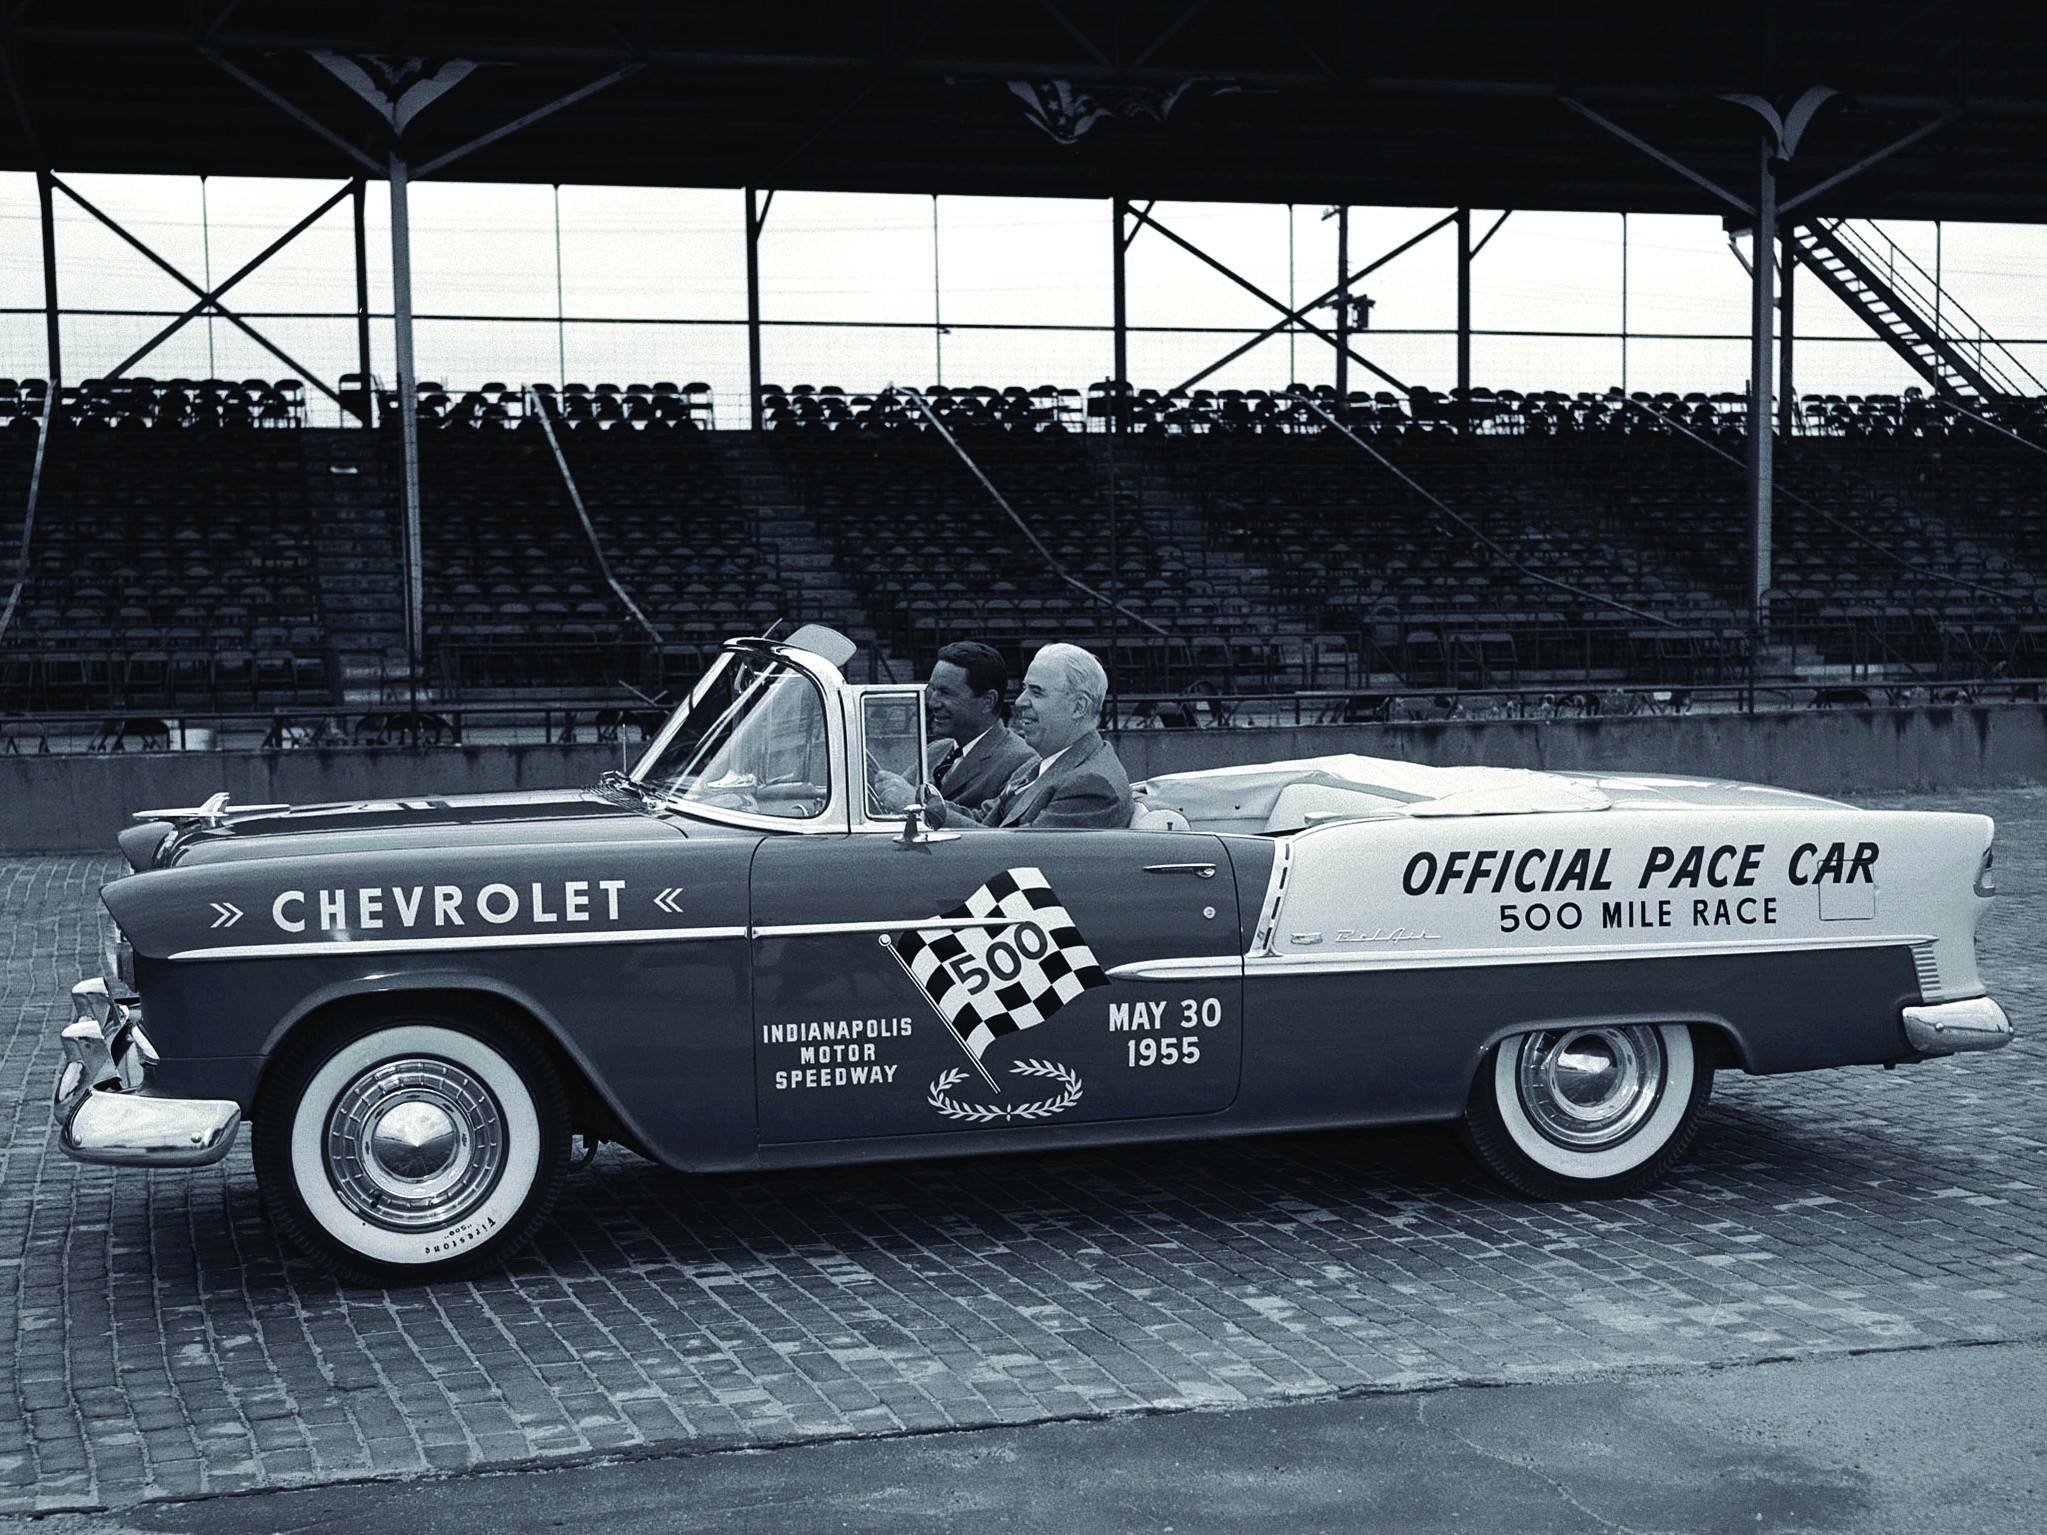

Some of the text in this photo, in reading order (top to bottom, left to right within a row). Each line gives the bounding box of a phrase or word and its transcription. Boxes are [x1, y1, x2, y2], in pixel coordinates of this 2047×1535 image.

[1402, 842, 1879, 896] OFFICIAL PACE CAR
[272, 880, 626, 932] CHEVROLET
[1499, 897, 1777, 933] 500 MILE RACE
[949, 920, 1049, 996] 500
[762, 1017, 913, 1044] INDIANAPOLIS
[1108, 998, 1222, 1032] MAY 30
[800, 1043, 876, 1065] MOTOR
[1127, 1036, 1201, 1067] 1955
[775, 1064, 898, 1089] SPEEDWAY
[425, 1217, 496, 1254] Firestone
